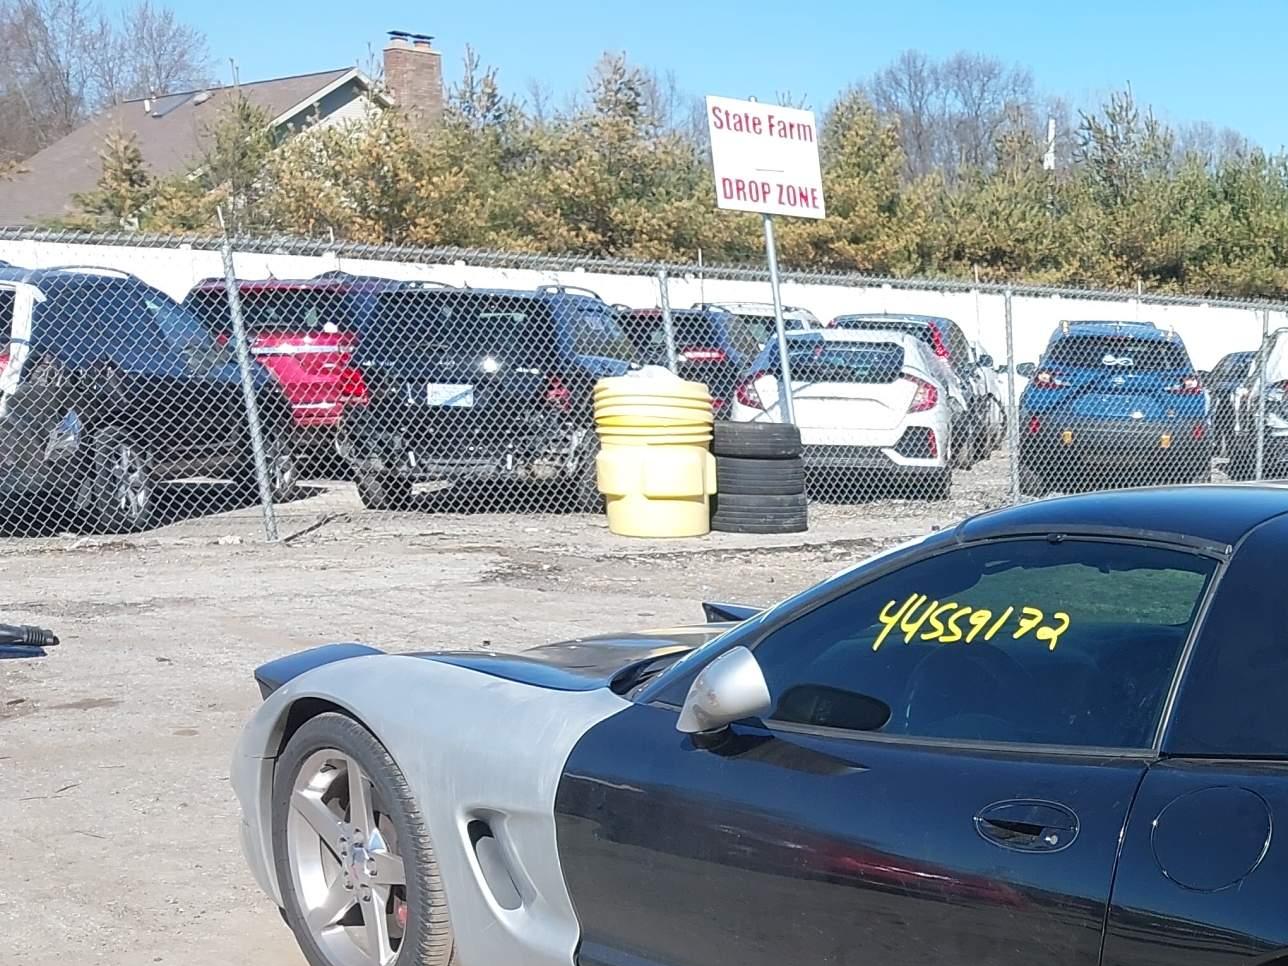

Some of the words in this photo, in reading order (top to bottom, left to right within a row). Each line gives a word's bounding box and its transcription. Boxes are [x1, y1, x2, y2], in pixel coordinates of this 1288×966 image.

[712, 106, 762, 134] State
[767, 115, 812, 142] Farm
[722, 177, 771, 203] DROP
[777, 184, 819, 209] ZONE
[872, 592, 1071, 651] 44559172
